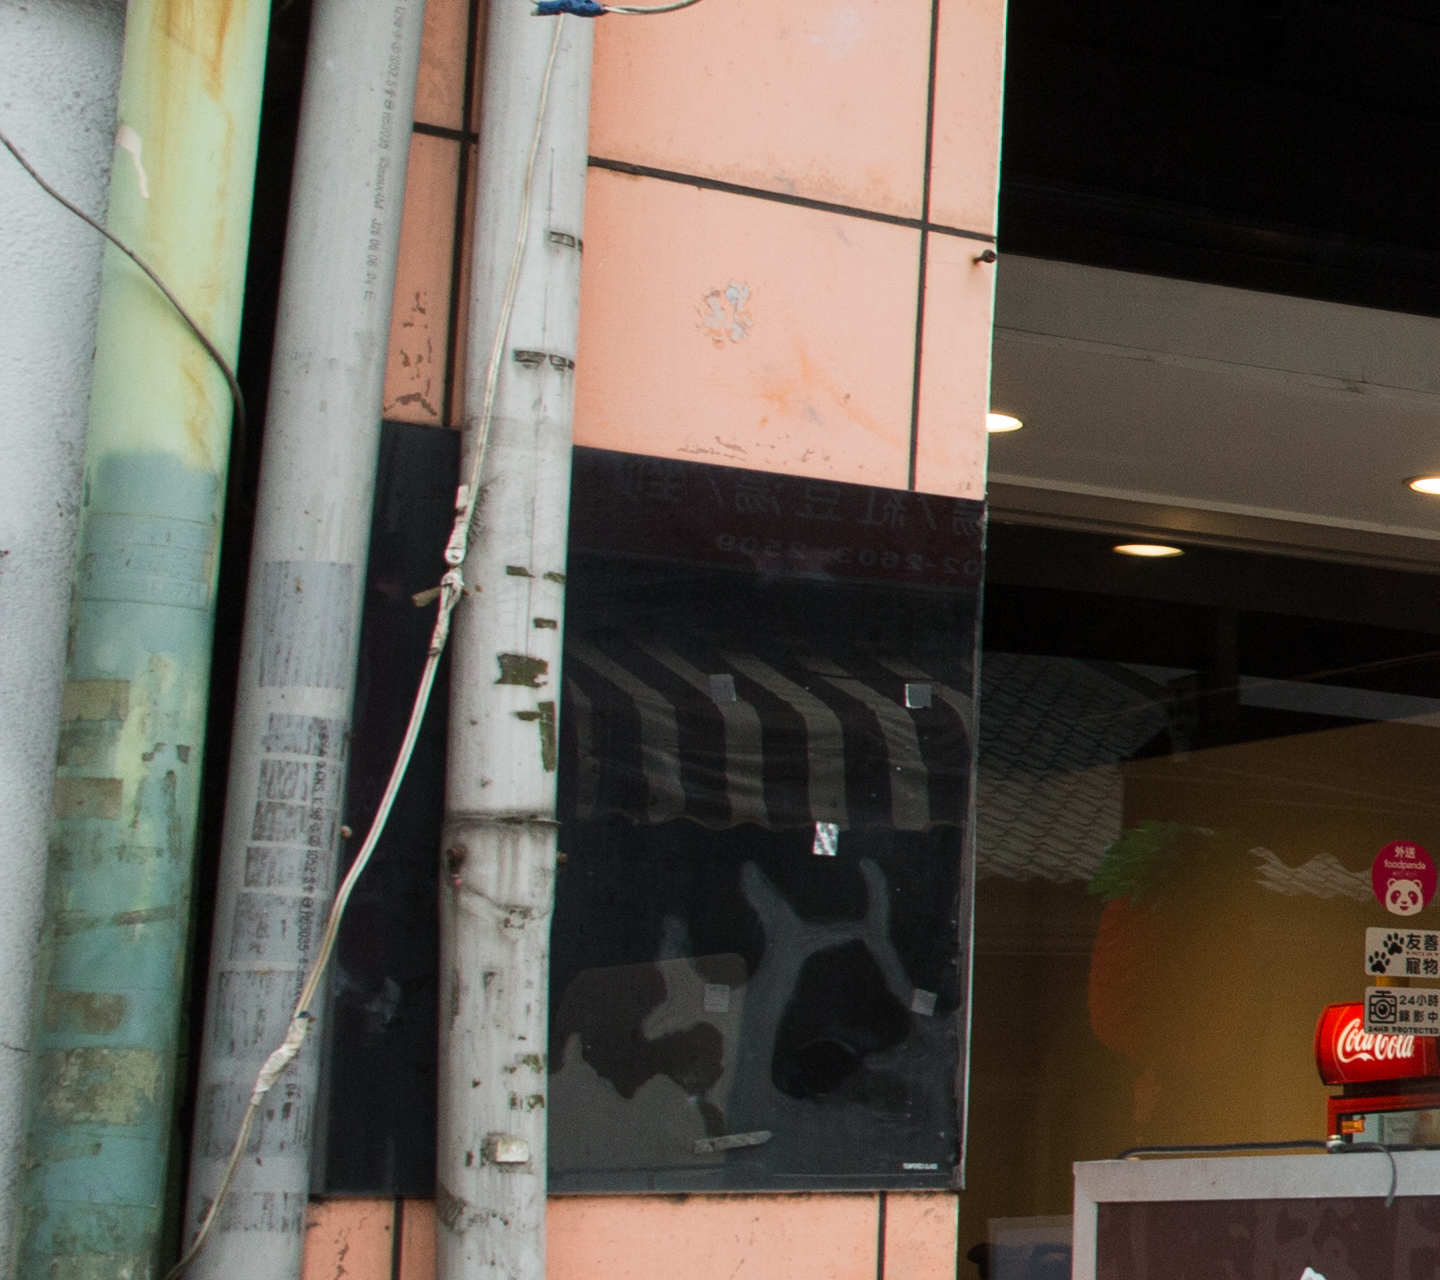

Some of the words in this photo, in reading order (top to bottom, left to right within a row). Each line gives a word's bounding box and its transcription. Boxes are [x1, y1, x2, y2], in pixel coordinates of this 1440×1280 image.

[1384, 859, 1426, 871] foodpanda
[1405, 932, 1439, 951] 友善
[1405, 957, 1439, 975] 寵物
[1399, 994, 1439, 1008] 24小時
[1391, 1026, 1439, 1034] PROTECTED
